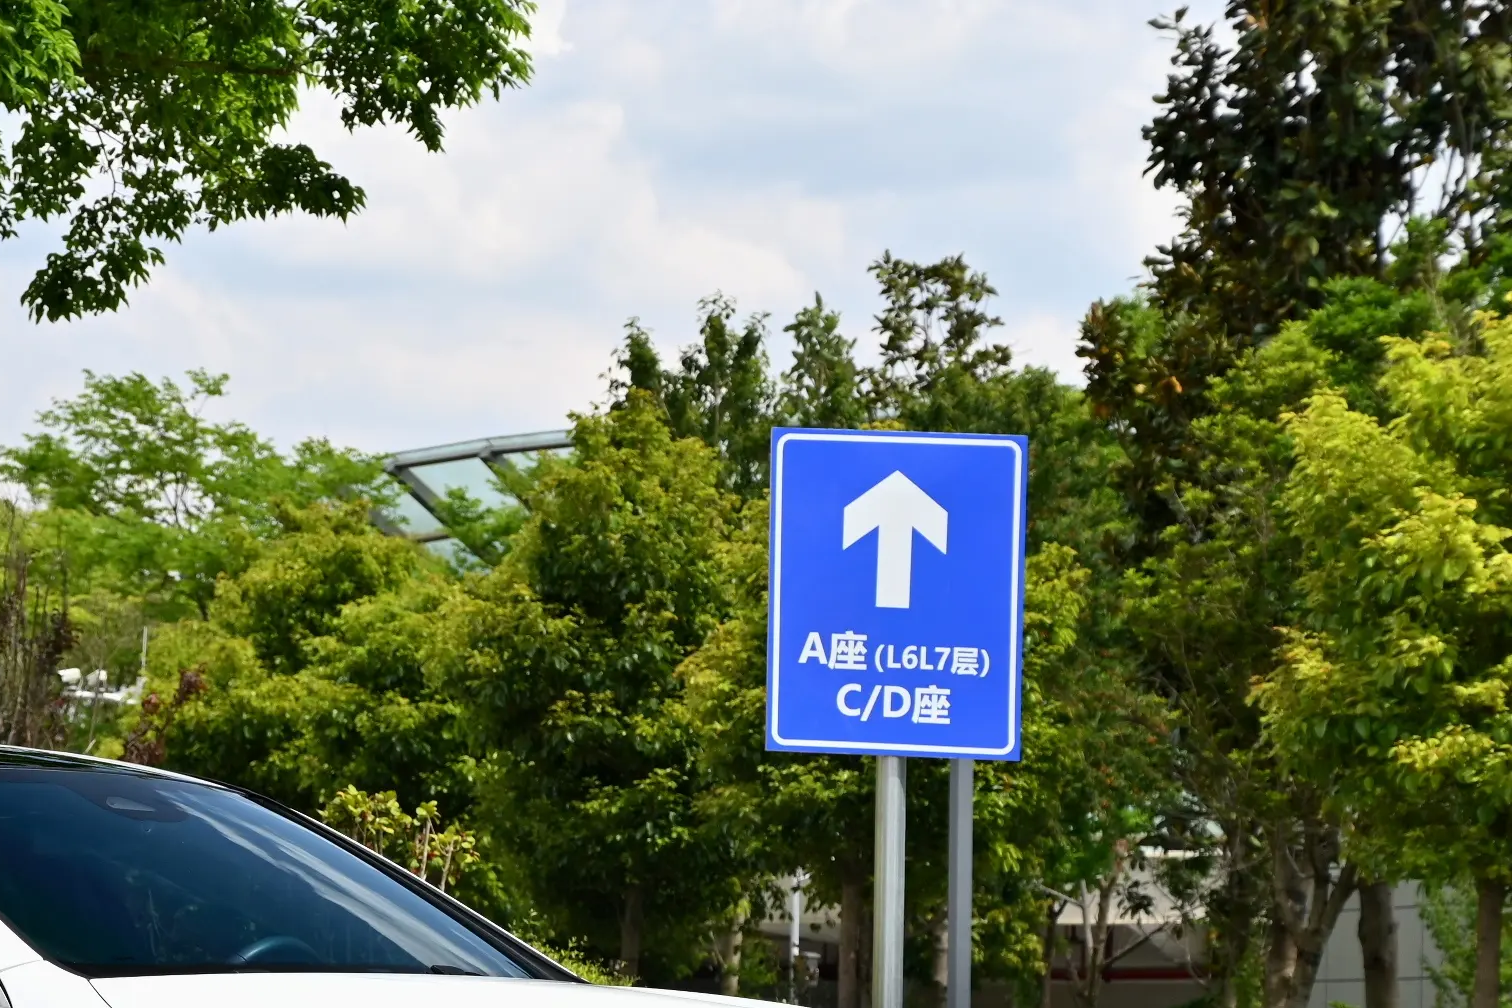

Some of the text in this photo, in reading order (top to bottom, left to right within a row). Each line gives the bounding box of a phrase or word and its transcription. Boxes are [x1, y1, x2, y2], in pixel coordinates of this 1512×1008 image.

[797, 630, 990, 678] A座 (L6L7层)
[836, 683, 951, 725] C/D座
